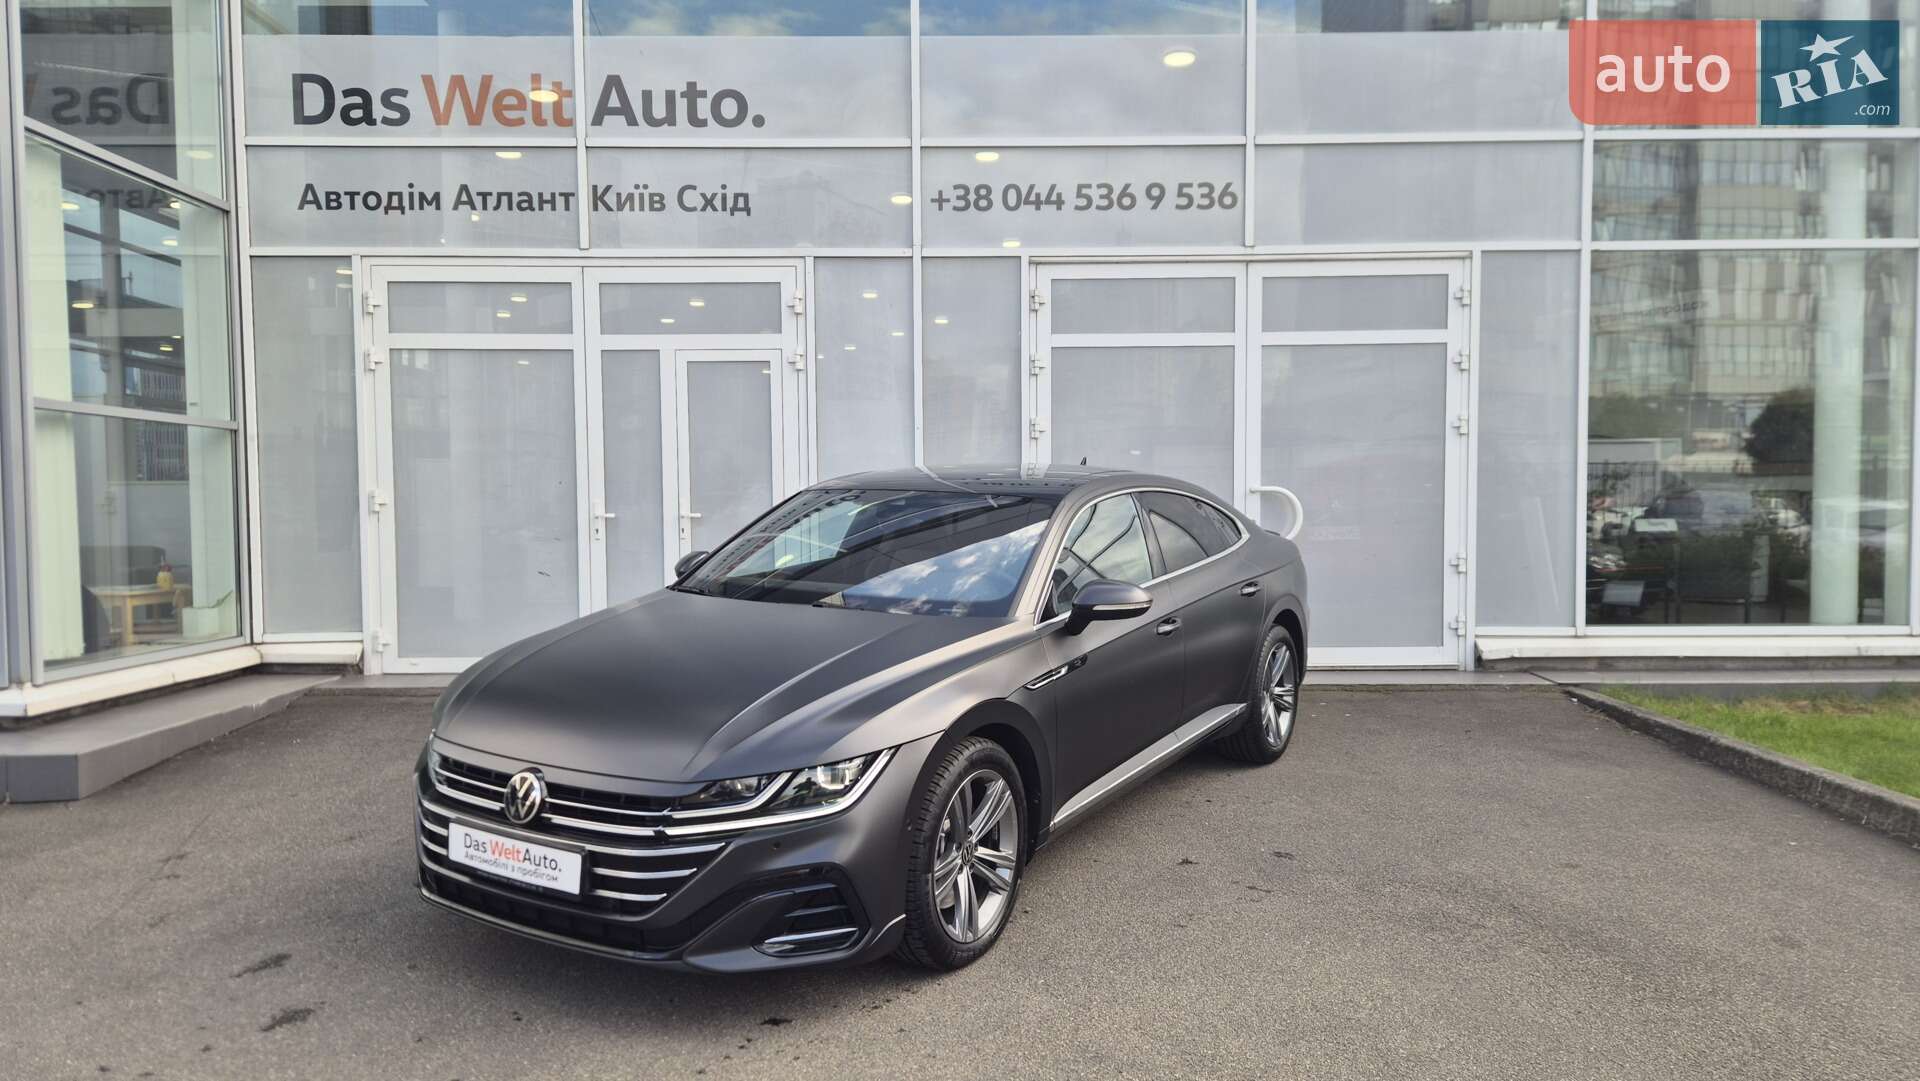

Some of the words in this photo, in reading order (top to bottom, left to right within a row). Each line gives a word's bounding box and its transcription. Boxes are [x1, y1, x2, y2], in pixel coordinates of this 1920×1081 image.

[292, 73, 411, 127] Das
[421, 73, 574, 127] Welt
[591, 74, 766, 128] Auto.
[297, 183, 442, 216] Автодім
[452, 183, 576, 212] Атлант
[591, 183, 666, 212] Київ
[676, 183, 752, 217] Схід
[930, 183, 994, 212] +38
[1001, 183, 1066, 212] 044
[1073, 182, 1137, 212] 536
[1145, 182, 1166, 210] 9
[1175, 181, 1239, 211] 536
[463, 833, 488, 853] Das
